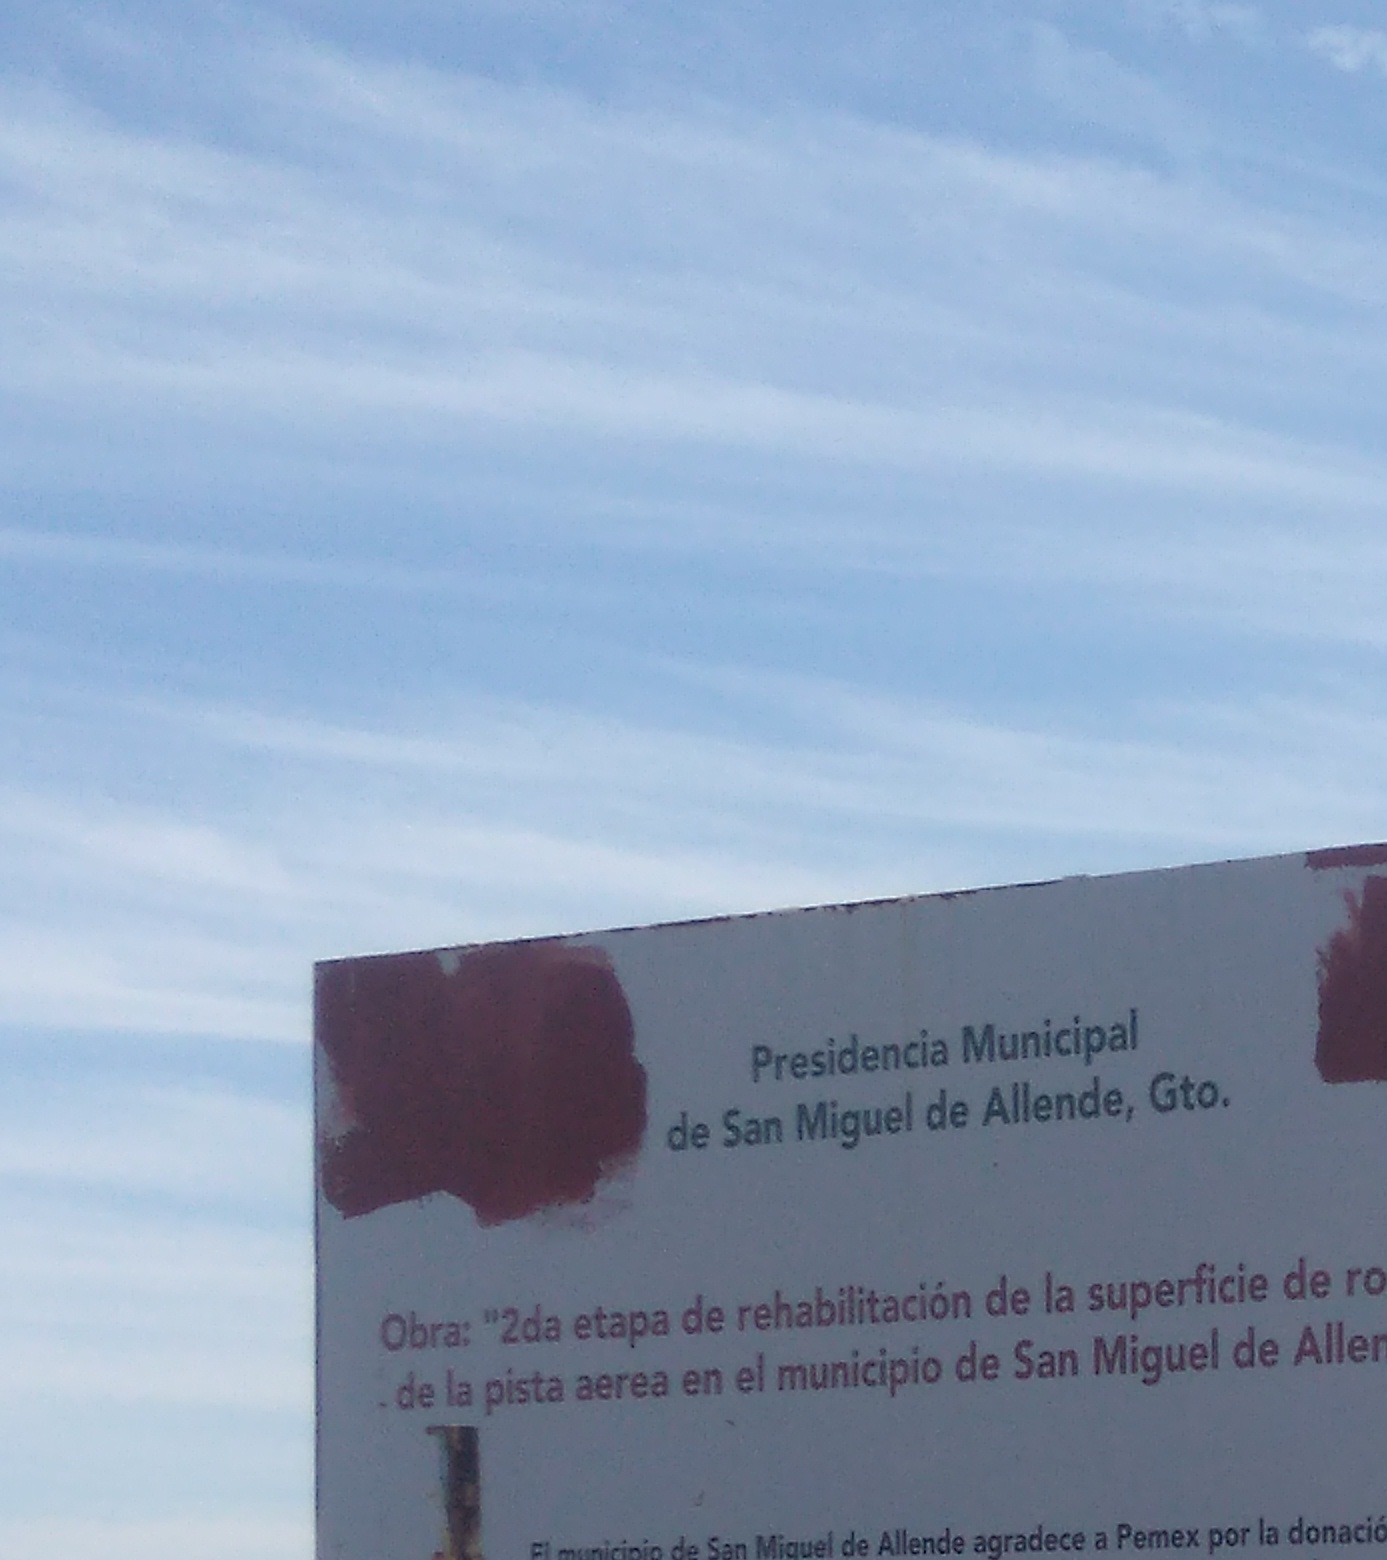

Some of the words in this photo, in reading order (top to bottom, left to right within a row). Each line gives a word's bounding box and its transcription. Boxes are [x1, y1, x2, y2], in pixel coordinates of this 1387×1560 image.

[751, 1029, 948, 1082] Presidencia
[961, 1008, 1139, 1069] Municipal
[667, 1113, 710, 1152] de
[723, 1109, 782, 1148] San
[797, 1094, 912, 1150] Miguel
[926, 1090, 968, 1130] de
[983, 1076, 1134, 1126] Allende,
[1149, 1071, 1229, 1113] Gto.
[381, 1310, 470, 1351] Obra:
[484, 1304, 561, 1345] "2da
[574, 1306, 669, 1348] etapa
[682, 1295, 725, 1335] de
[738, 1281, 971, 1332] rehabilitación
[986, 1275, 1031, 1318] de
[1045, 1271, 1075, 1314] la
[1088, 1262, 1268, 1320] superficie
[1283, 1258, 1331, 1301] de
[397, 1371, 434, 1410] de
[447, 1367, 472, 1407] la
[486, 1367, 564, 1416] pista
[575, 1363, 669, 1401] aerea
[683, 1365, 723, 1397] en
[736, 1352, 765, 1393] el
[778, 1346, 940, 1398] municipio
[955, 1341, 1000, 1383] de
[1014, 1339, 1079, 1380] San
[1094, 1328, 1218, 1386] Miguel
[1233, 1326, 1279, 1369] de
[842, 1531, 869, 1557] de
[877, 1528, 964, 1556] Allende
[973, 1525, 1086, 1560] agradece
[1095, 1531, 1107, 1550] a
[1117, 1523, 1200, 1550] Pemex
[1208, 1526, 1250, 1554] por
[1259, 1518, 1279, 1546] la
